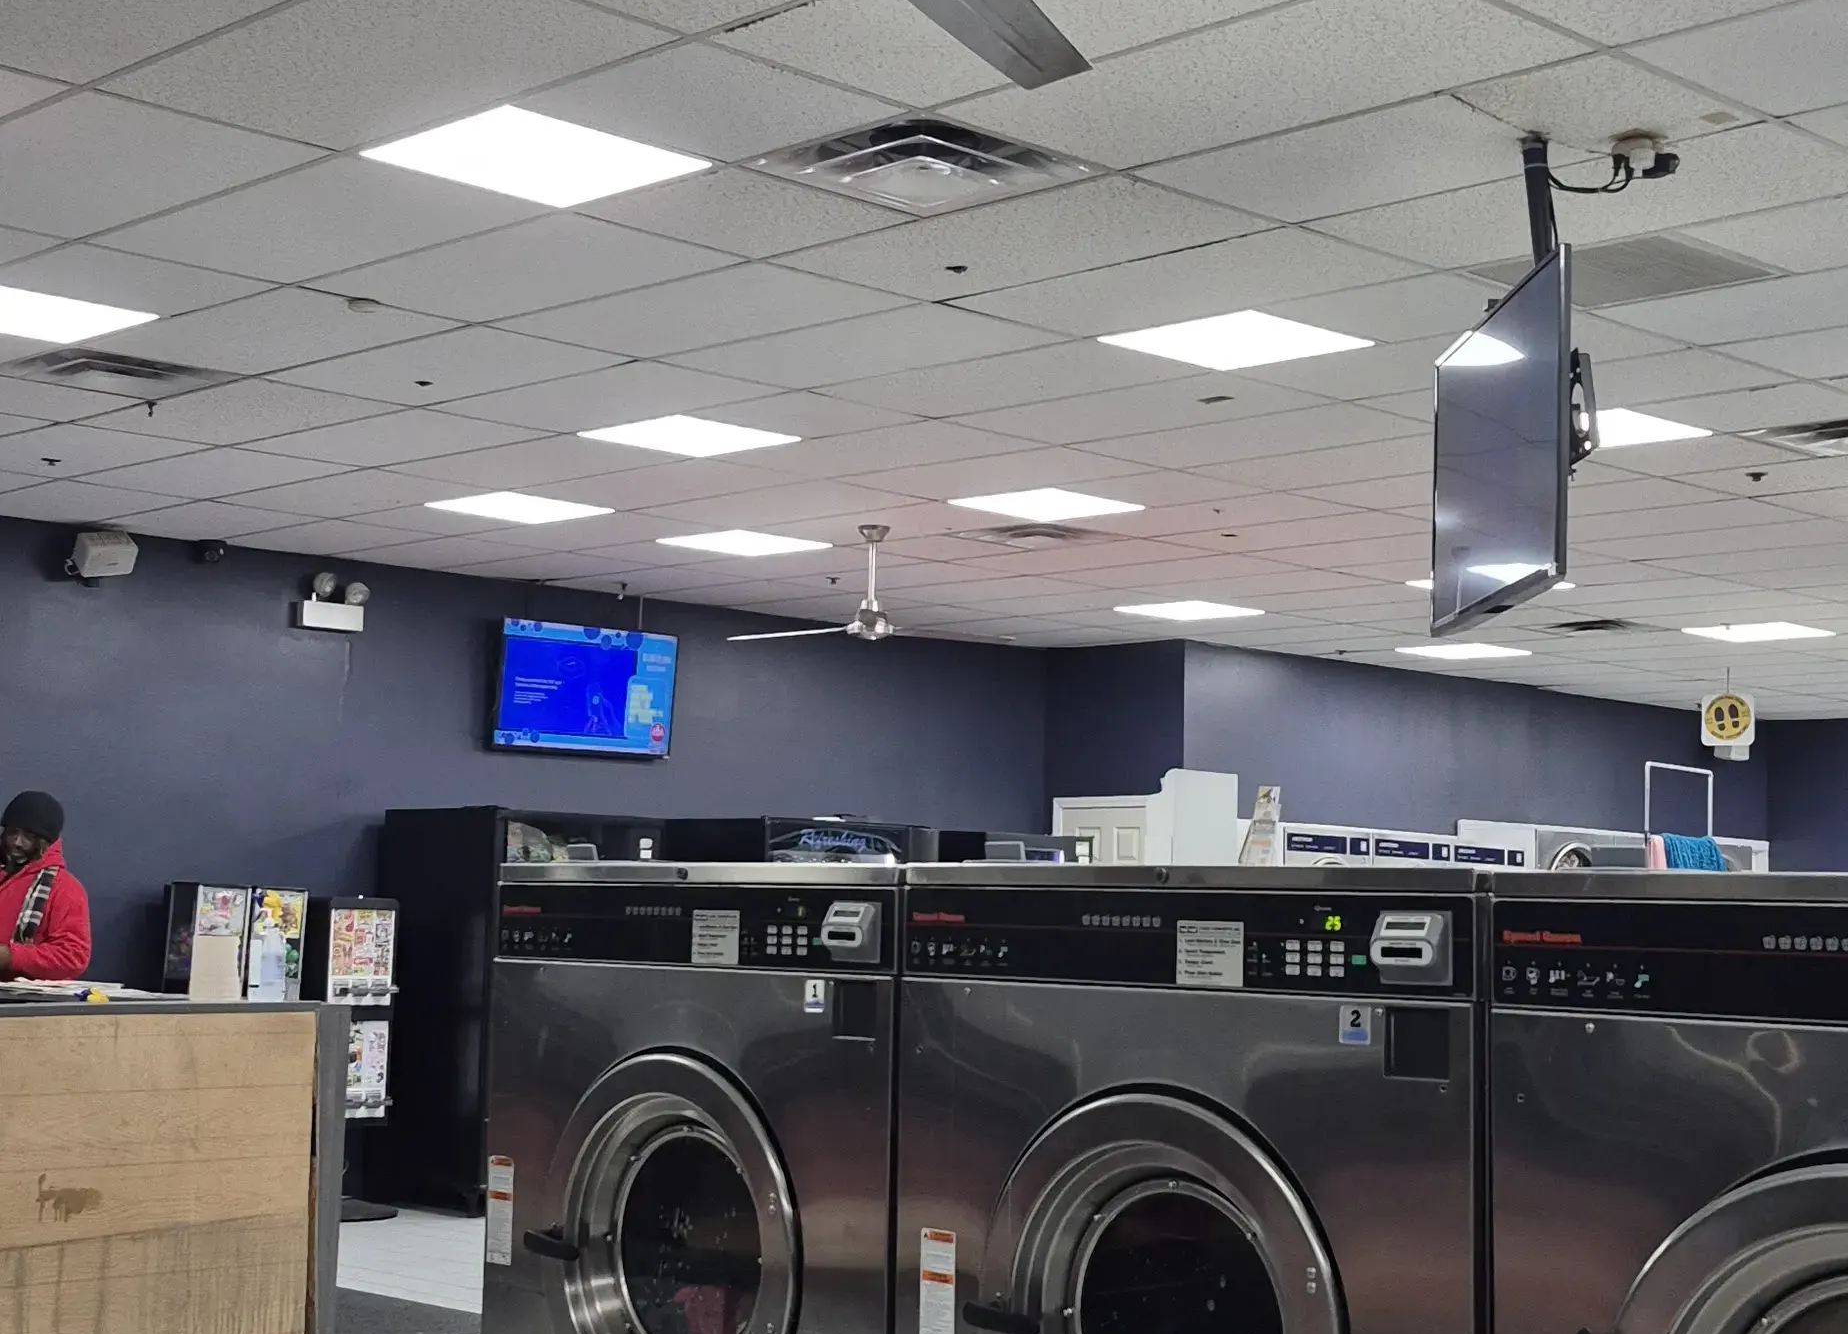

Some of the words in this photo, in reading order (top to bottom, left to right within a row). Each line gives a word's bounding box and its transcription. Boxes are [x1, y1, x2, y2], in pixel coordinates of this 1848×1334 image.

[1324, 915, 1342, 932] 25
[811, 982, 819, 998] 1
[1350, 1009, 1362, 1028] 2
